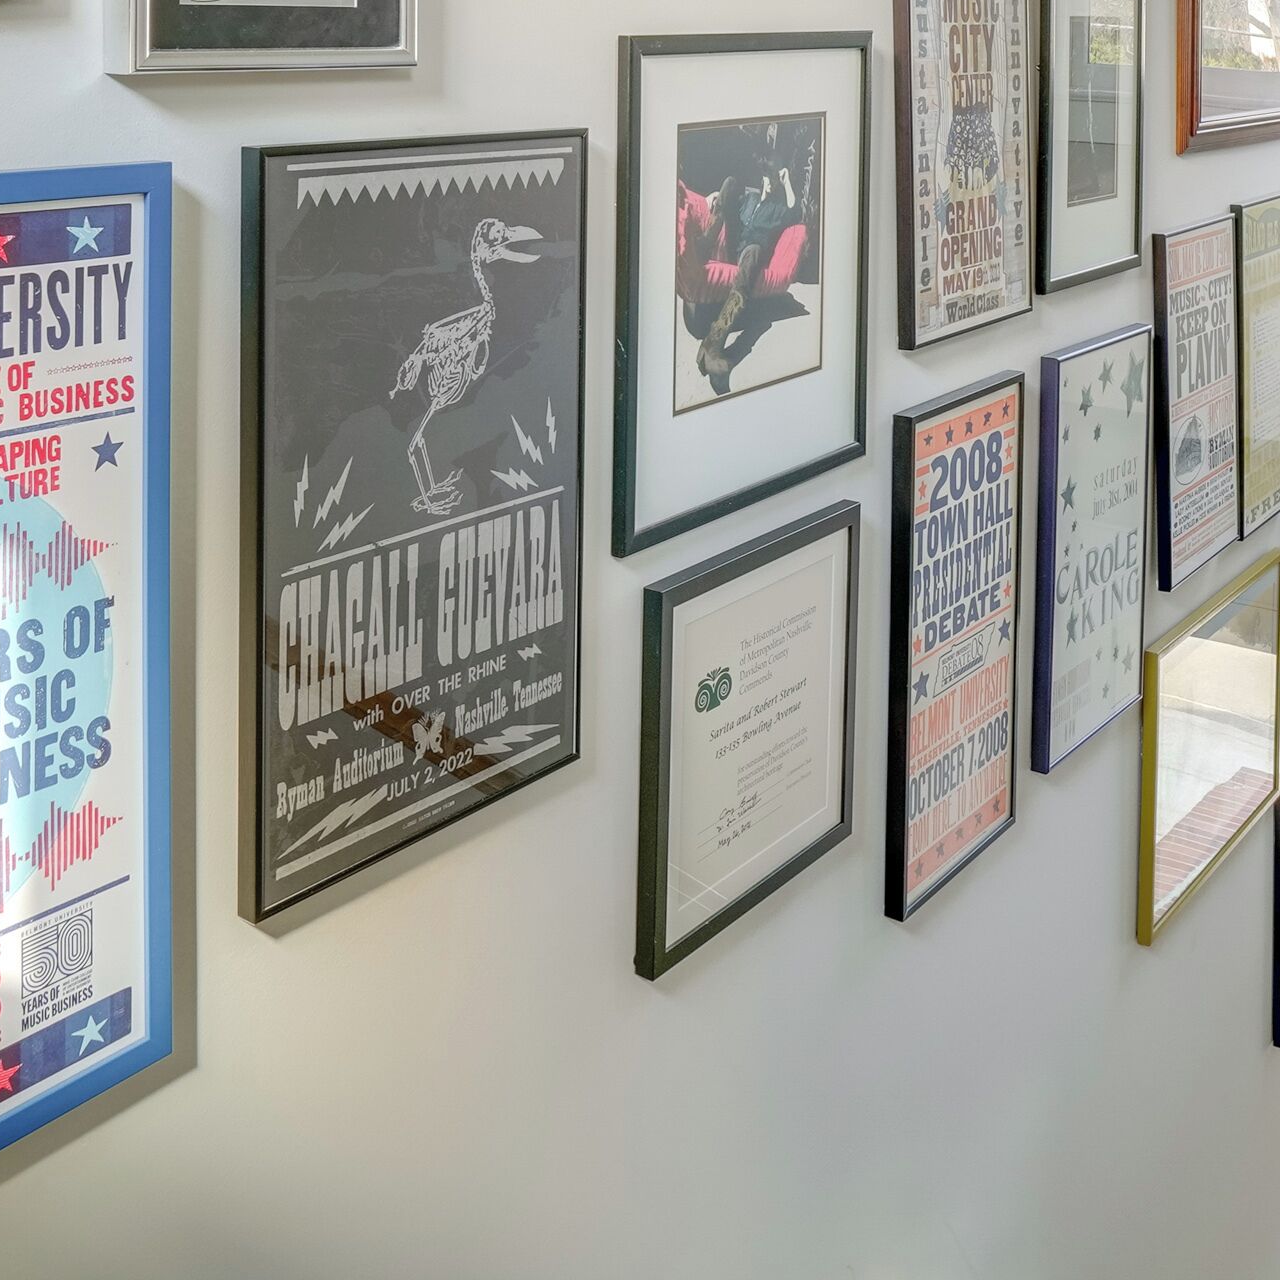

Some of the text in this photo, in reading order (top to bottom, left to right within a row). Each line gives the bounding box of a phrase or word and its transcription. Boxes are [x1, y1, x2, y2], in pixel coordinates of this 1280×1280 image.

[949, 24, 994, 73] CITY
[952, 73, 993, 112] CENTER
[946, 194, 997, 235] GRAND
[941, 227, 1002, 271] OPENING
[943, 271, 969, 296] MAY
[1169, 274, 1231, 315] MUSIC CITY!
[946, 294, 999, 323] World Class
[1176, 298, 1227, 344] KEEP ON
[7, 361, 36, 392] OF
[1176, 324, 1230, 400] PLAYIN'
[19, 375, 136, 419] BUSINESS
[929, 430, 1003, 513] 2008
[1094, 456, 1138, 491] saturday
[915, 479, 1013, 565] TOWN HALL
[1092, 498, 1105, 520] july
[912, 521, 1011, 629] PRESIDENTIAL
[1056, 527, 1138, 605] CAROLE
[61, 595, 115, 659] OF
[279, 499, 564, 731] CHAGALL GUEVARA
[740, 606, 816, 650] The Historical Commission
[924, 581, 1001, 651] DEBATE
[1081, 568, 1139, 639] KING
[739, 620, 812, 666] of Metropolitan Nashville
[740, 648, 789, 680] Davidson County
[353, 654, 507, 731] with OVER THE RHINE
[739, 670, 773, 695] Commends
[909, 689, 957, 760] BELMONT
[959, 654, 1009, 723] UNIVERSITY
[710, 677, 807, 742] Sarita and Robert Stewart
[715, 701, 801, 760] 133-135 Bowling Avenue
[276, 781, 325, 820] Ryman
[332, 740, 404, 794] Auditorium
[512, 671, 562, 712] Tennessee
[386, 748, 475, 802] JULY 2, 2022
[909, 743, 965, 821] OCTOBER
[909, 753, 1007, 858] FROM HERE TO ANYWHERE
[22, 985, 61, 1015] YEARS OF
[22, 985, 93, 1032] MUSIC BUSINESS
